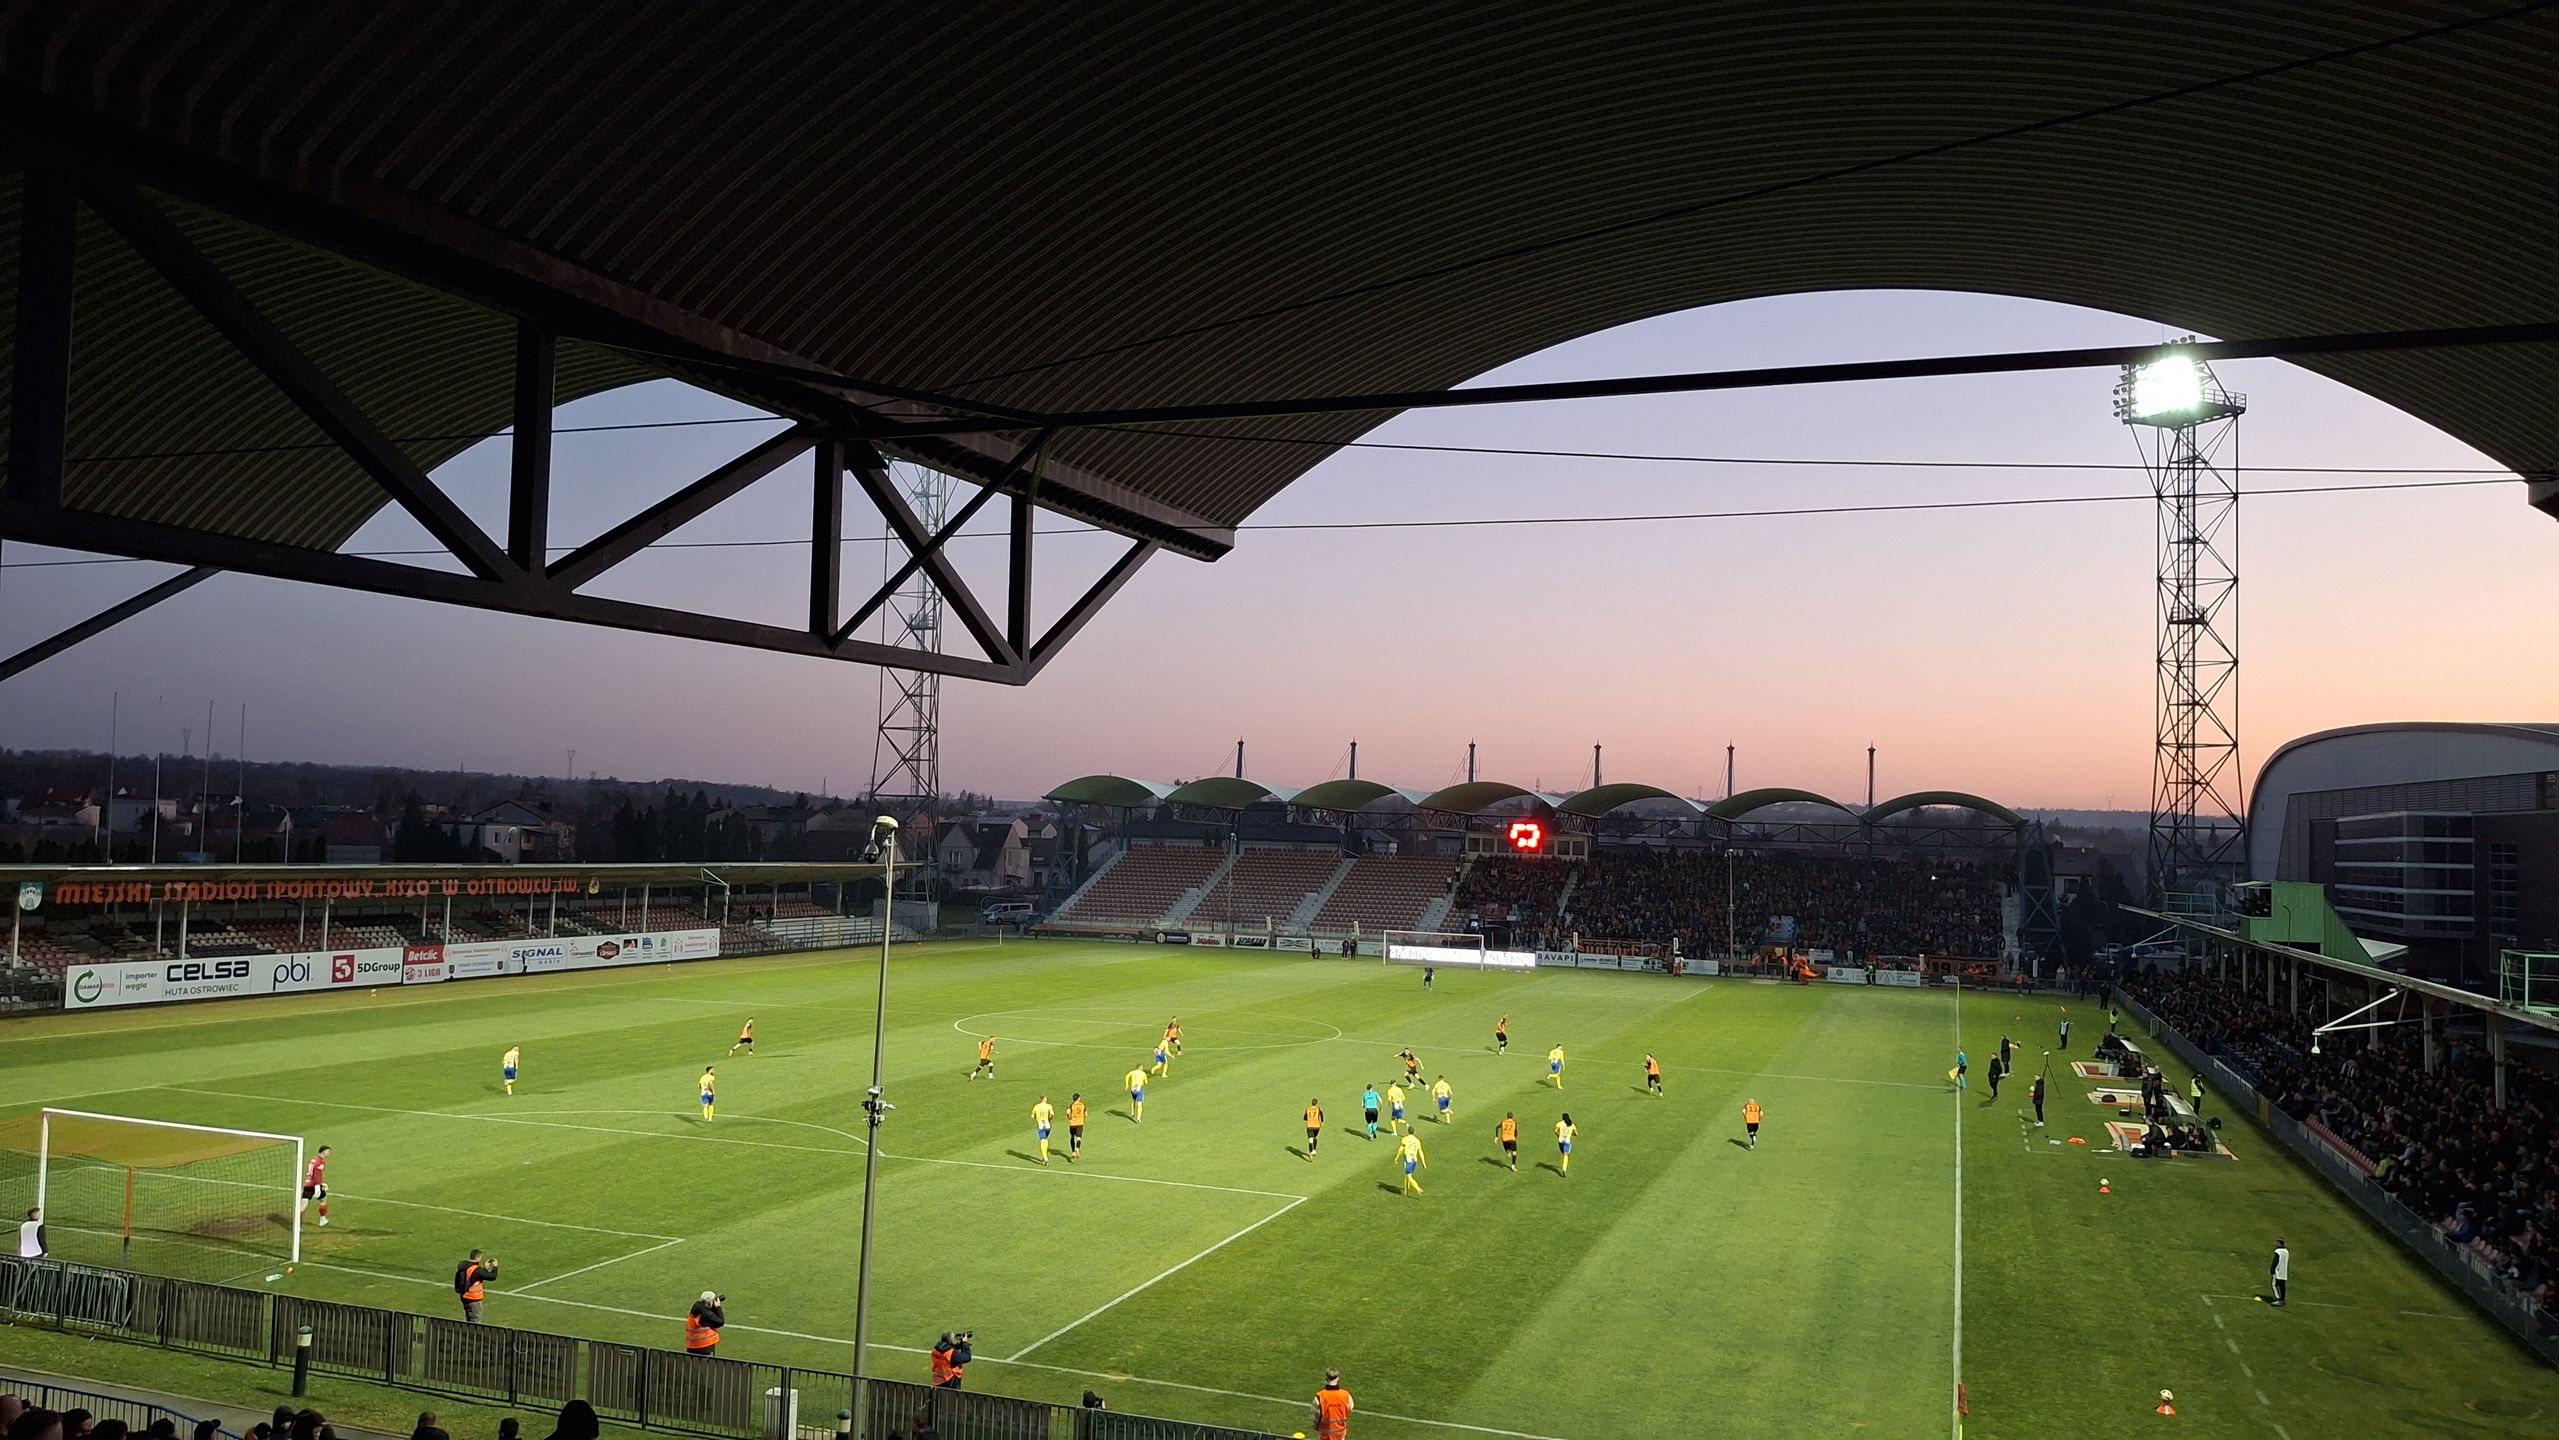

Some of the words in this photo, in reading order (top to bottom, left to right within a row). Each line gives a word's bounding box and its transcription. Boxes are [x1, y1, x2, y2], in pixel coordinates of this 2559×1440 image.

[55, 881, 152, 904] MIEJSKI
[163, 880, 258, 901] STADION
[266, 879, 374, 899] SPORTOWY
[442, 879, 459, 896] W
[466, 878, 552, 895] OSTROWCU
[407, 949, 440, 961] Betclic
[1537, 953, 1574, 962] RAVAPI
[273, 955, 310, 991] pbi
[357, 962, 401, 973] 5DGroup
[125, 972, 158, 981] importer
[164, 987, 189, 996] HUTA
[189, 983, 240, 995] OSTROWIEC
